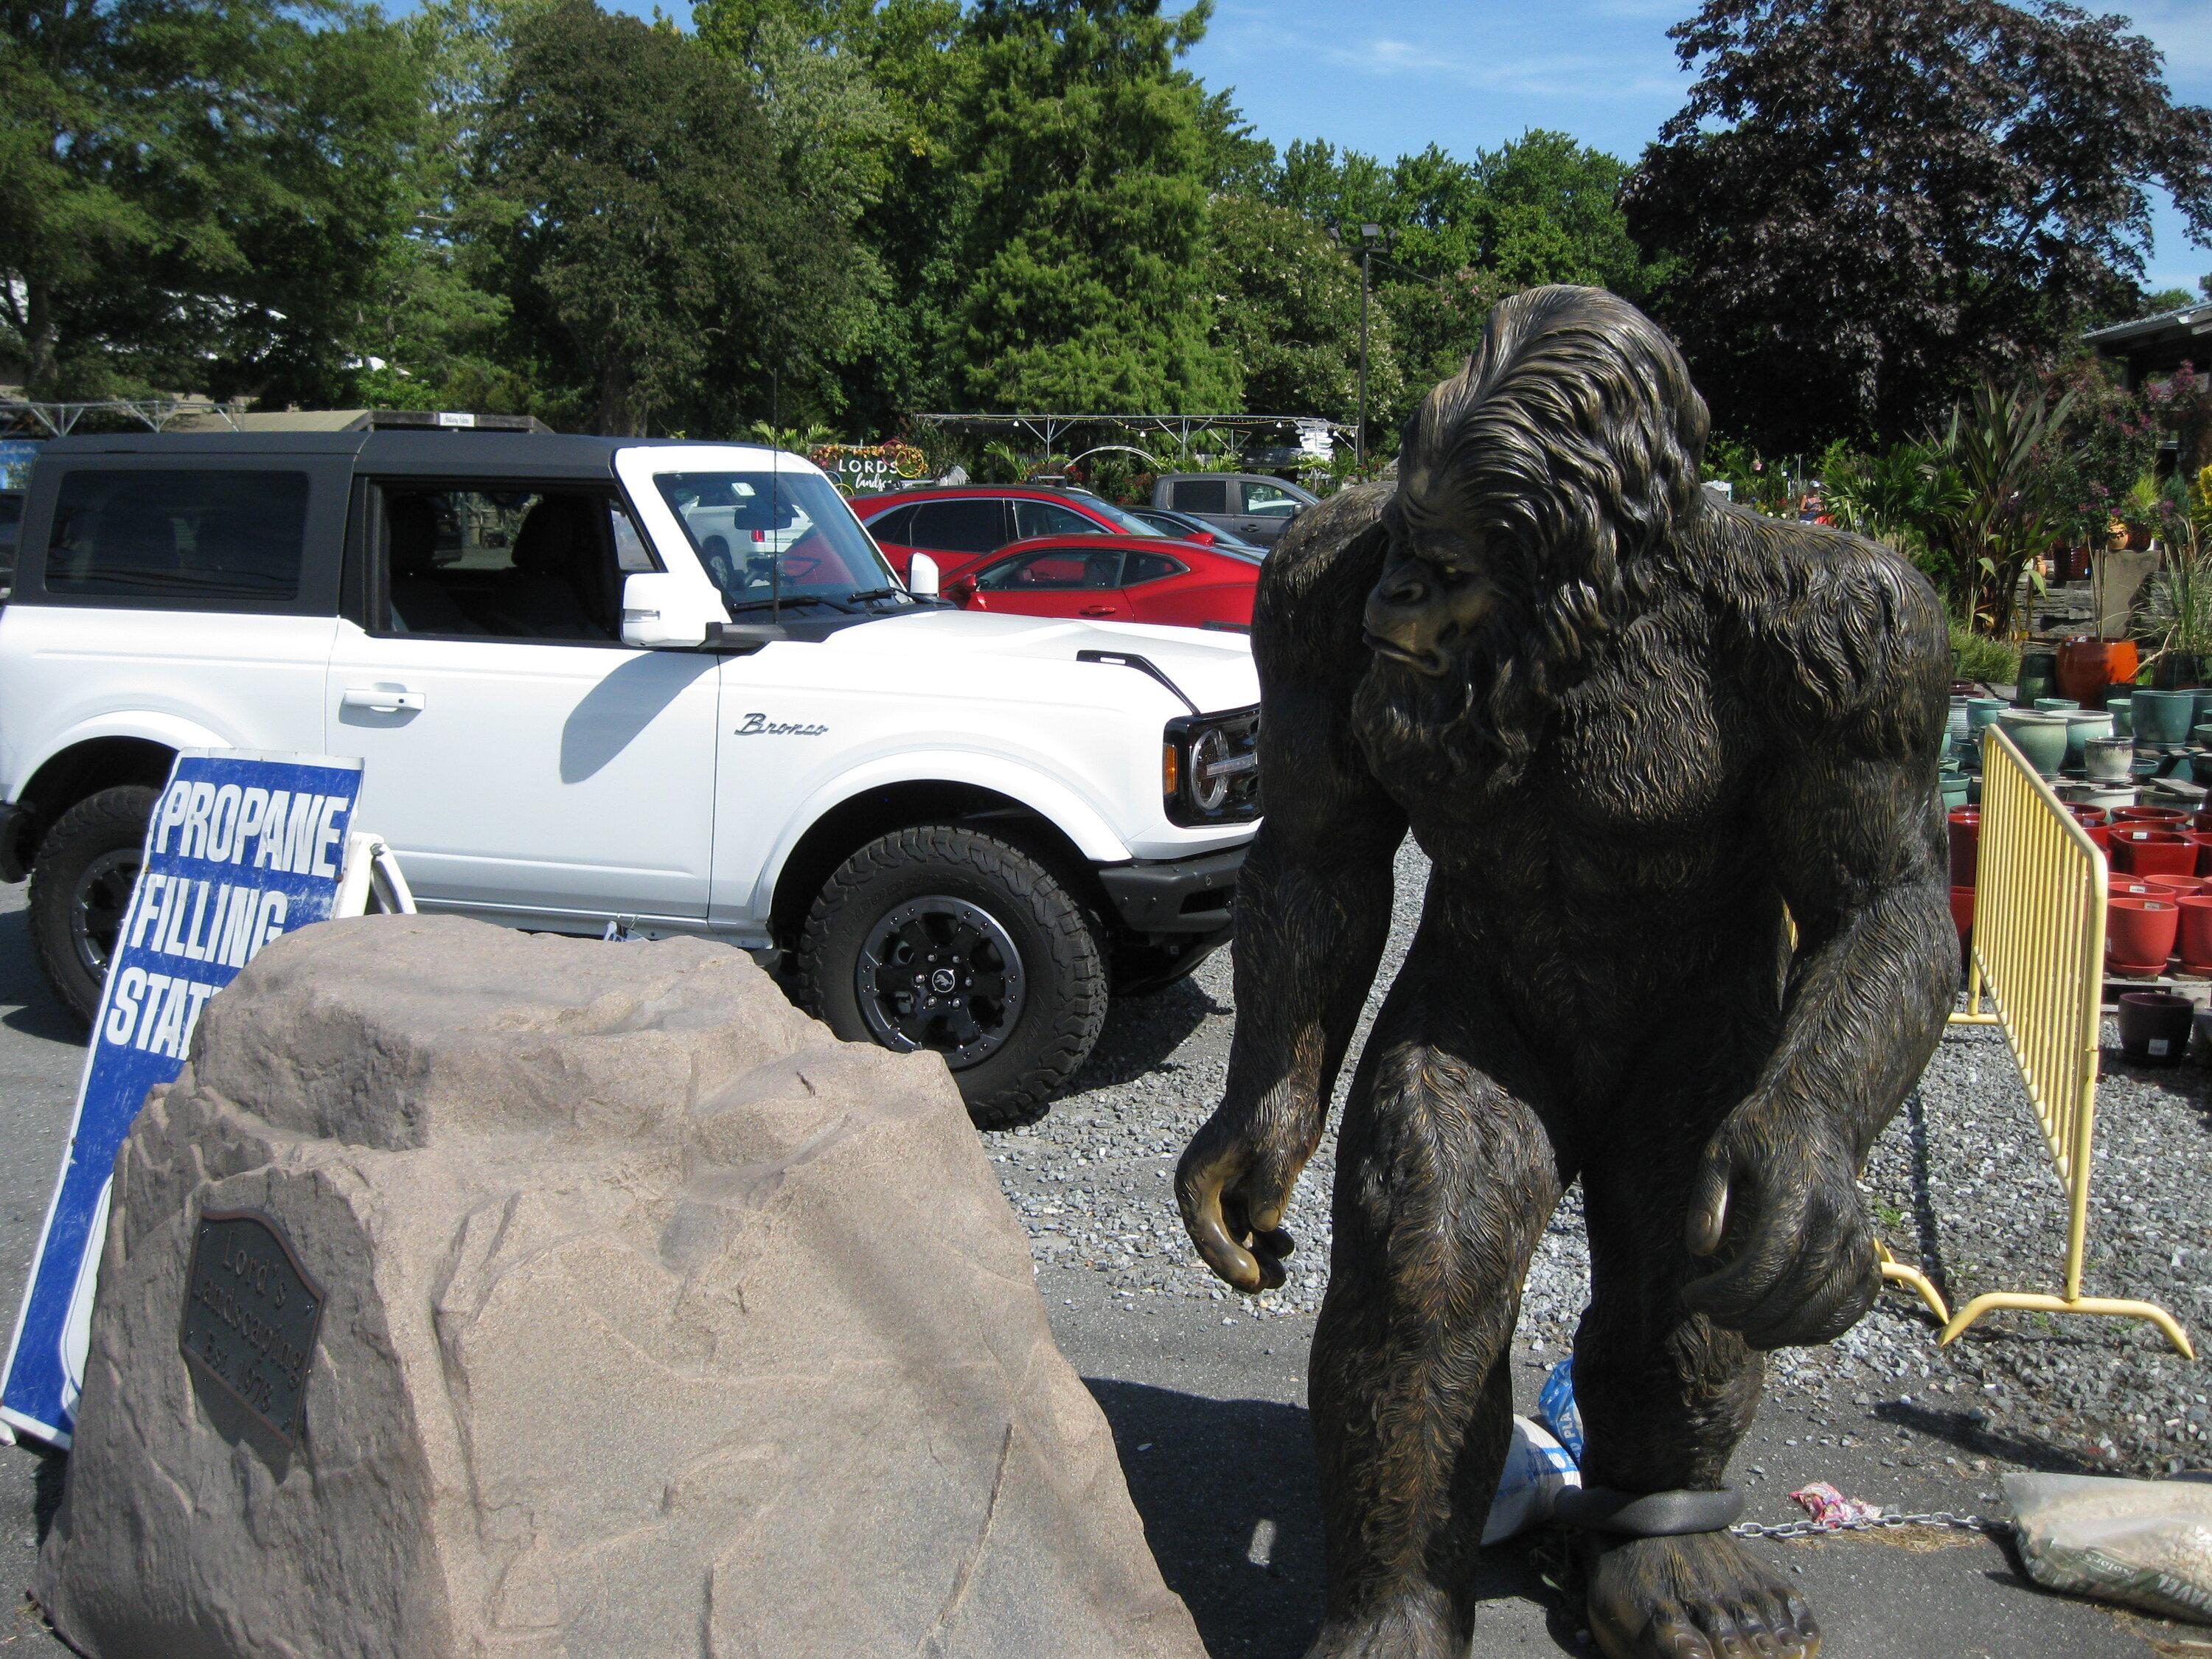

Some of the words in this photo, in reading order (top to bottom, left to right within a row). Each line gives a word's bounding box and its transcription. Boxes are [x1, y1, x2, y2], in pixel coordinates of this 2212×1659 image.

[838, 459, 899, 474] LORDS
[734, 712, 830, 736] Bronco
[155, 780, 349, 878] PROPANE
[131, 873, 288, 969] FILLING
[106, 967, 223, 1061] STAT
